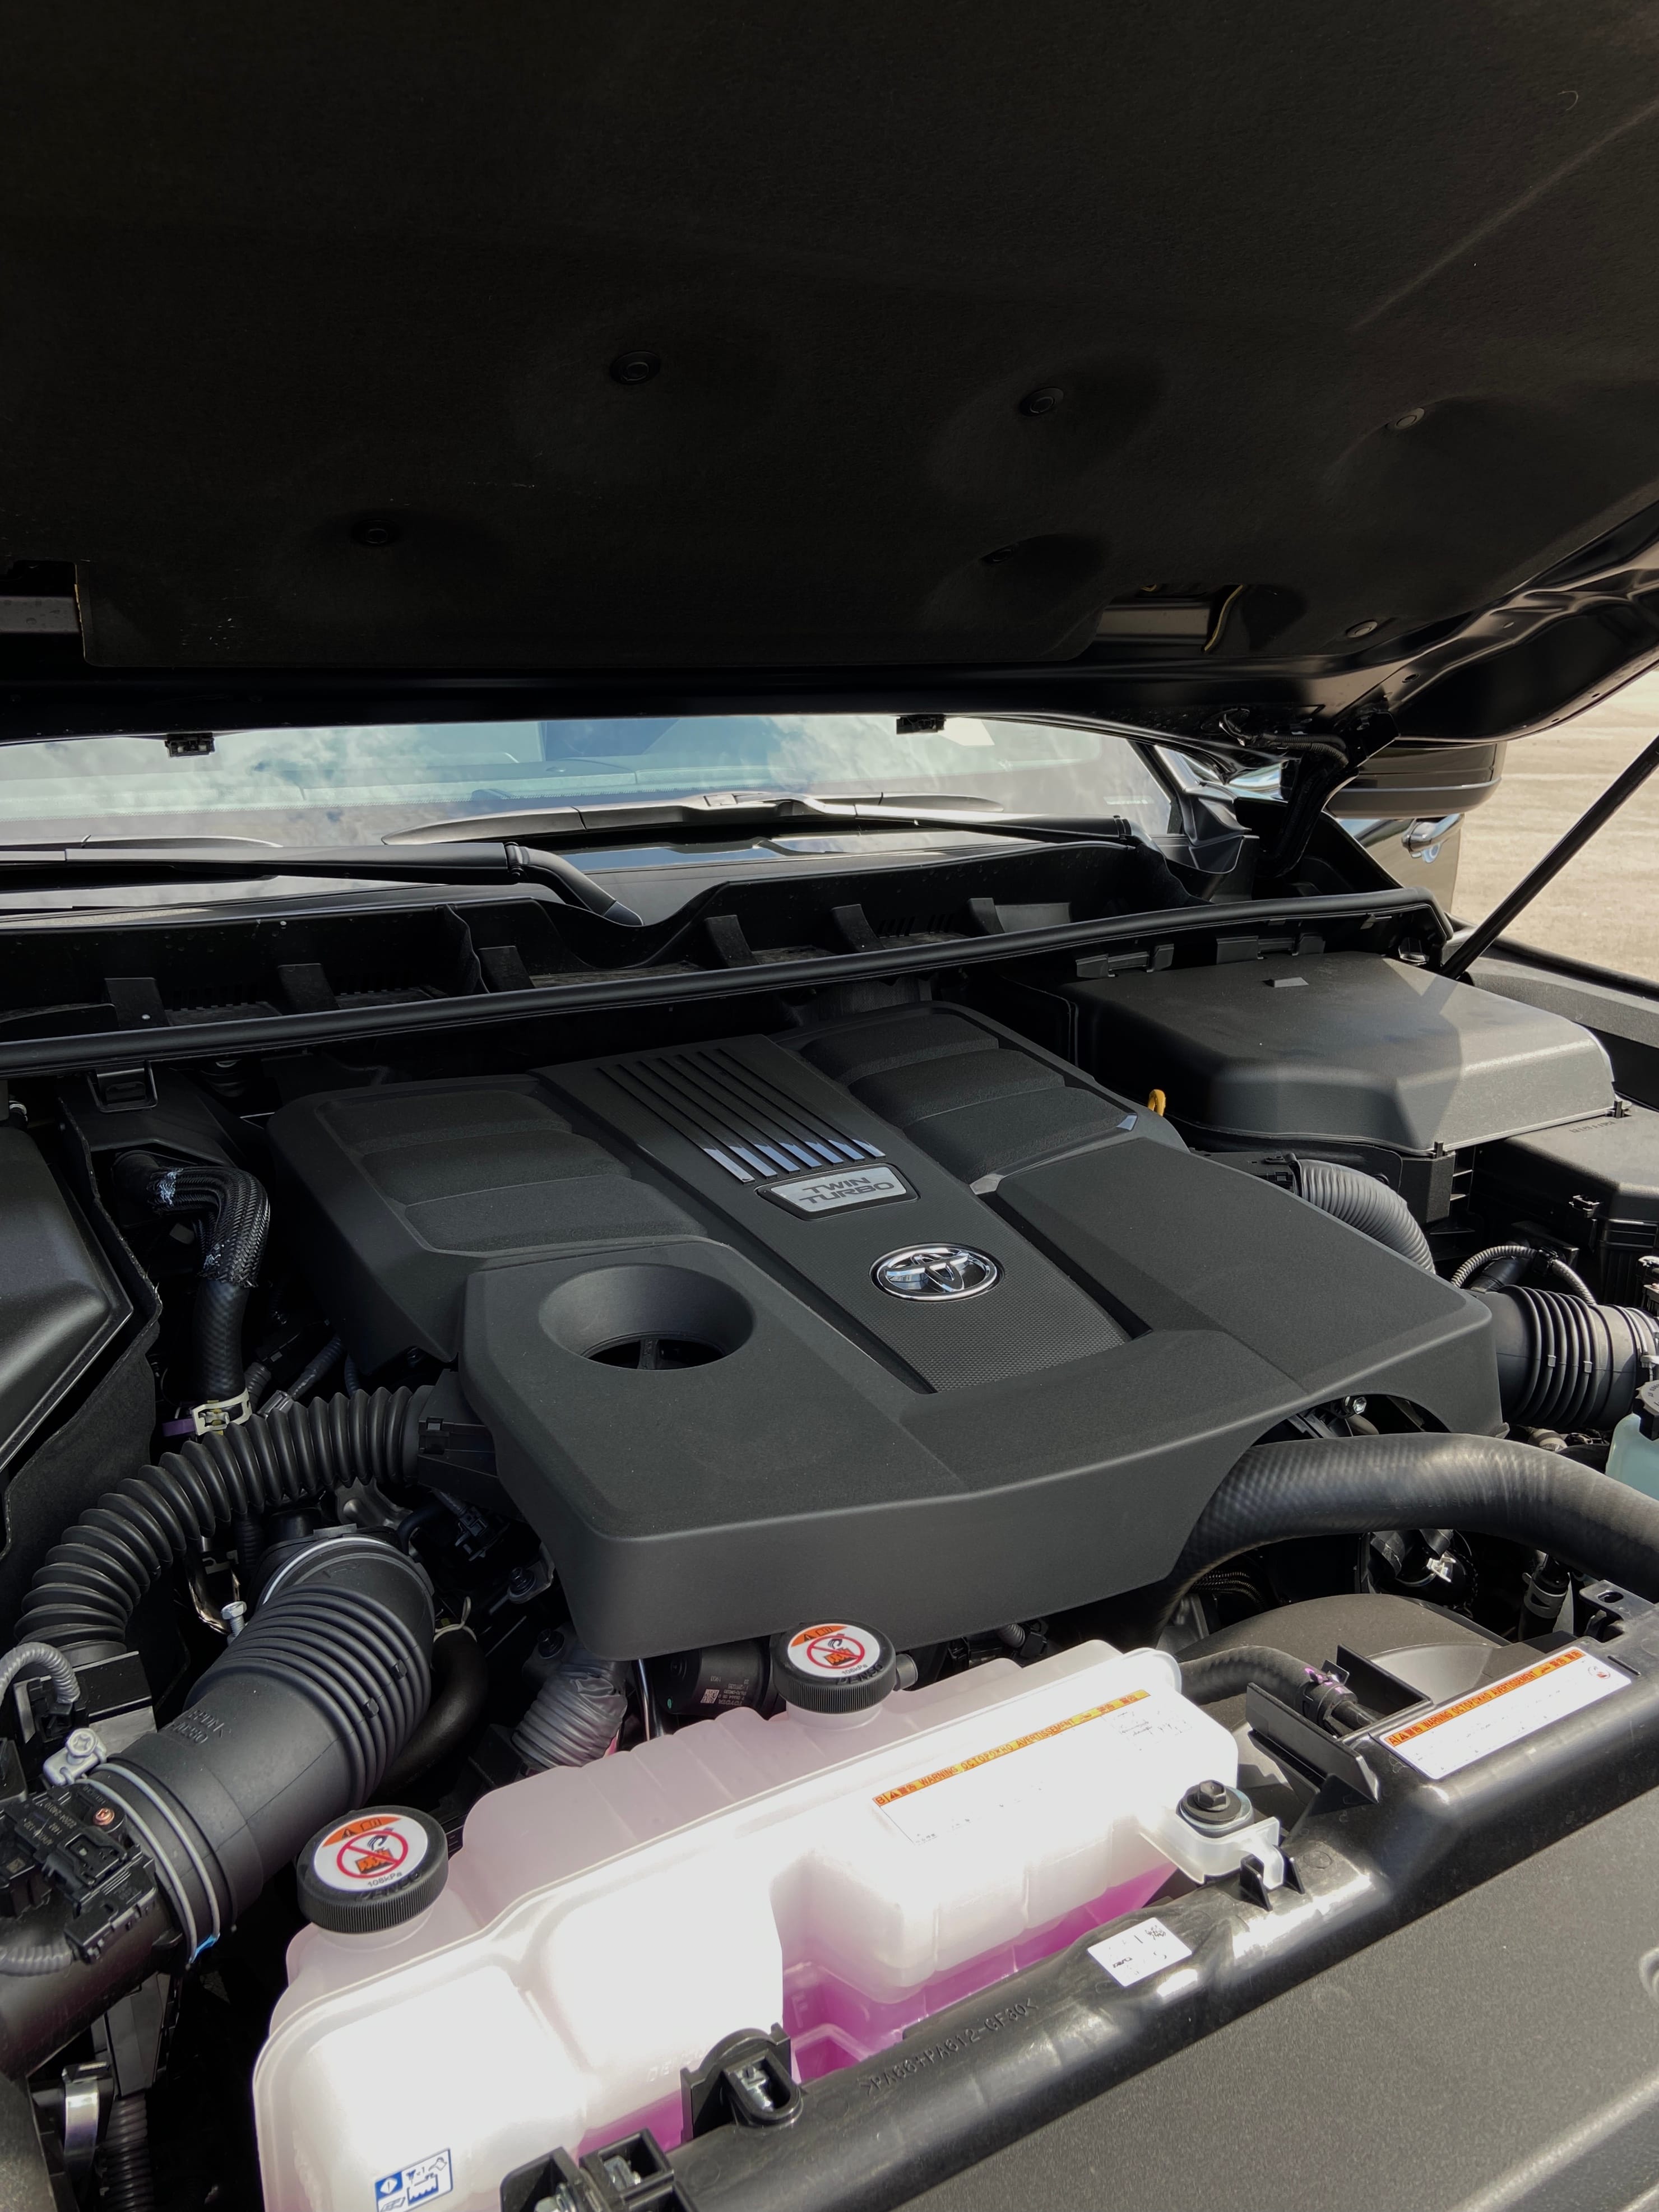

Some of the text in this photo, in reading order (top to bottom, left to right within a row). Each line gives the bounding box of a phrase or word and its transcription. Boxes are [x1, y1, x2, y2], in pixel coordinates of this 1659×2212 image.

[799, 1182, 895, 1204] TURBO
[803, 1177, 870, 1193] TWIN
[1421, 1710, 1453, 1728] WARNING
[1491, 1671, 1536, 1696] AVERTISSEMENT
[875, 1796, 886, 1805] B
[919, 1766, 958, 1787] WARNING
[1016, 1718, 1076, 1747] AVERTISSEMENT
